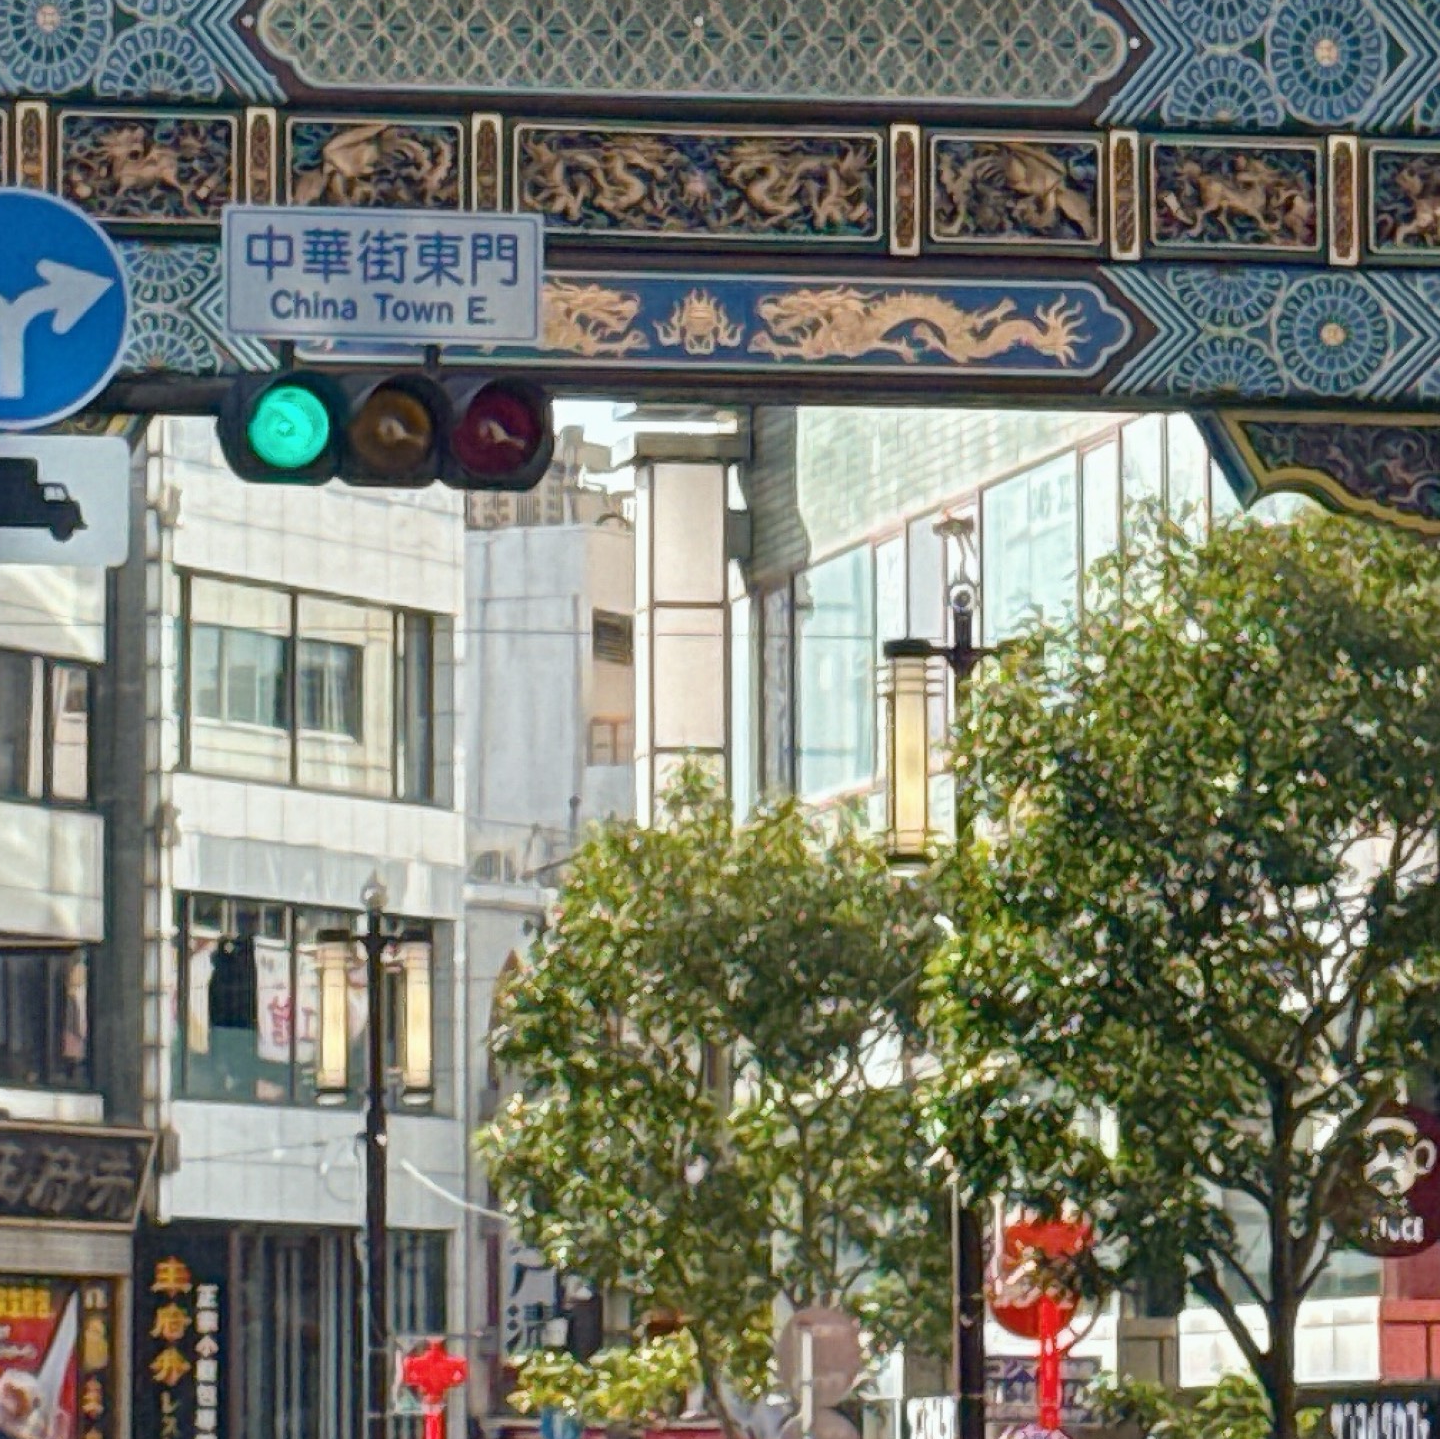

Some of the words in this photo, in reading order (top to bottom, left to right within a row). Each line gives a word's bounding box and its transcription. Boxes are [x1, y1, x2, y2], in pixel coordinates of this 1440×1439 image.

[244, 224, 519, 287] 中華街東門
[270, 289, 358, 322] China
[373, 293, 454, 324] Town
[467, 296, 496, 325] E.
